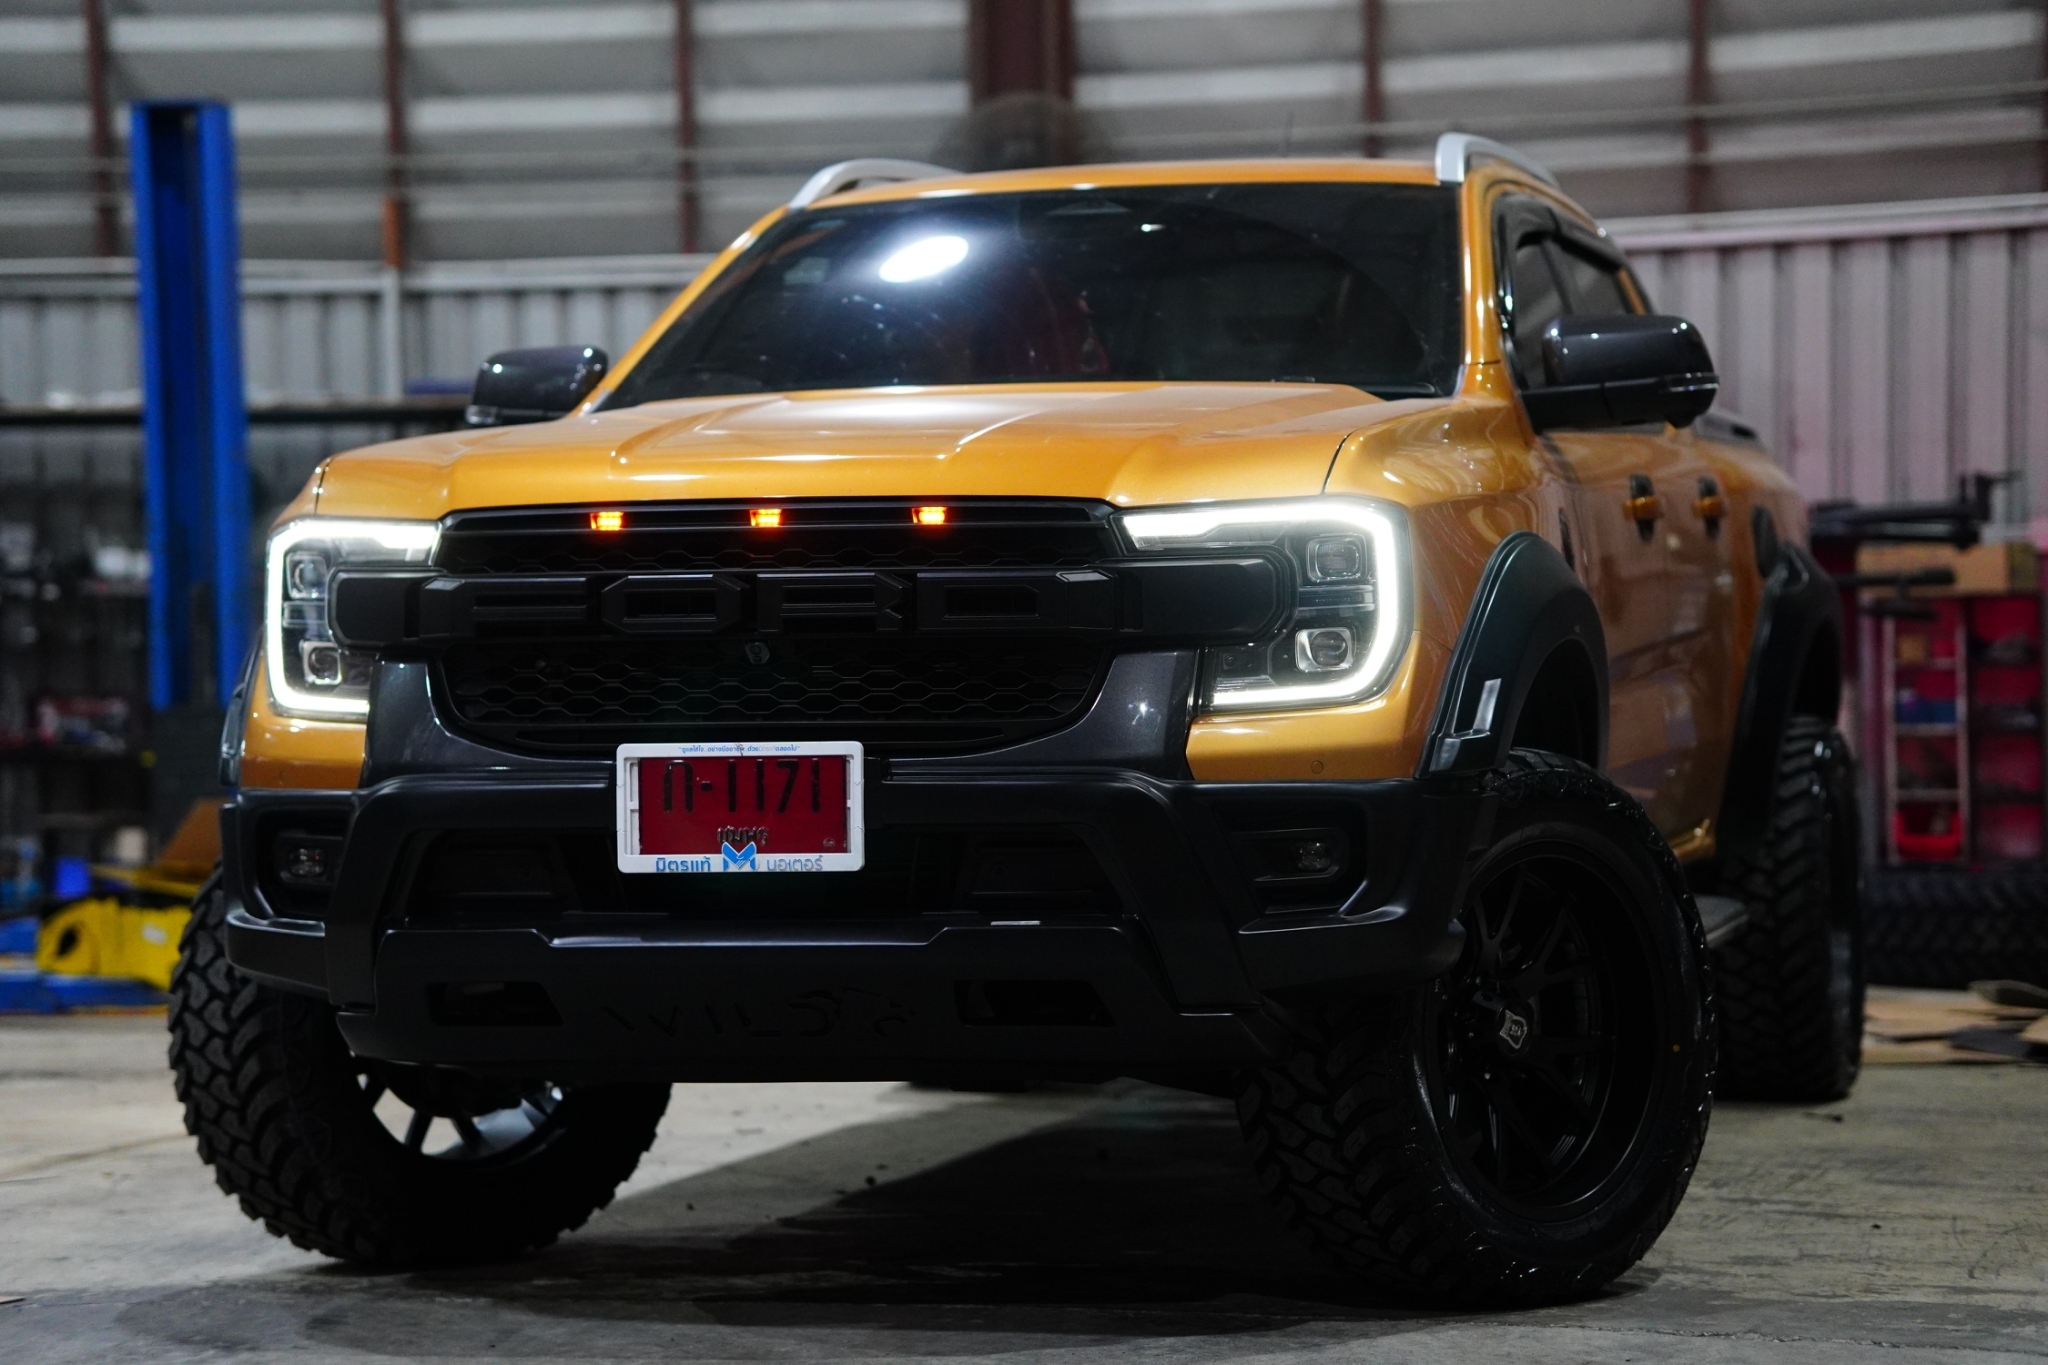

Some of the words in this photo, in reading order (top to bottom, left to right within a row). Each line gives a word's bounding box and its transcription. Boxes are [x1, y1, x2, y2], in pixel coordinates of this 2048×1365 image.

[421, 571, 1113, 637] FORD
[655, 856, 711, 872] มิตรแท้
